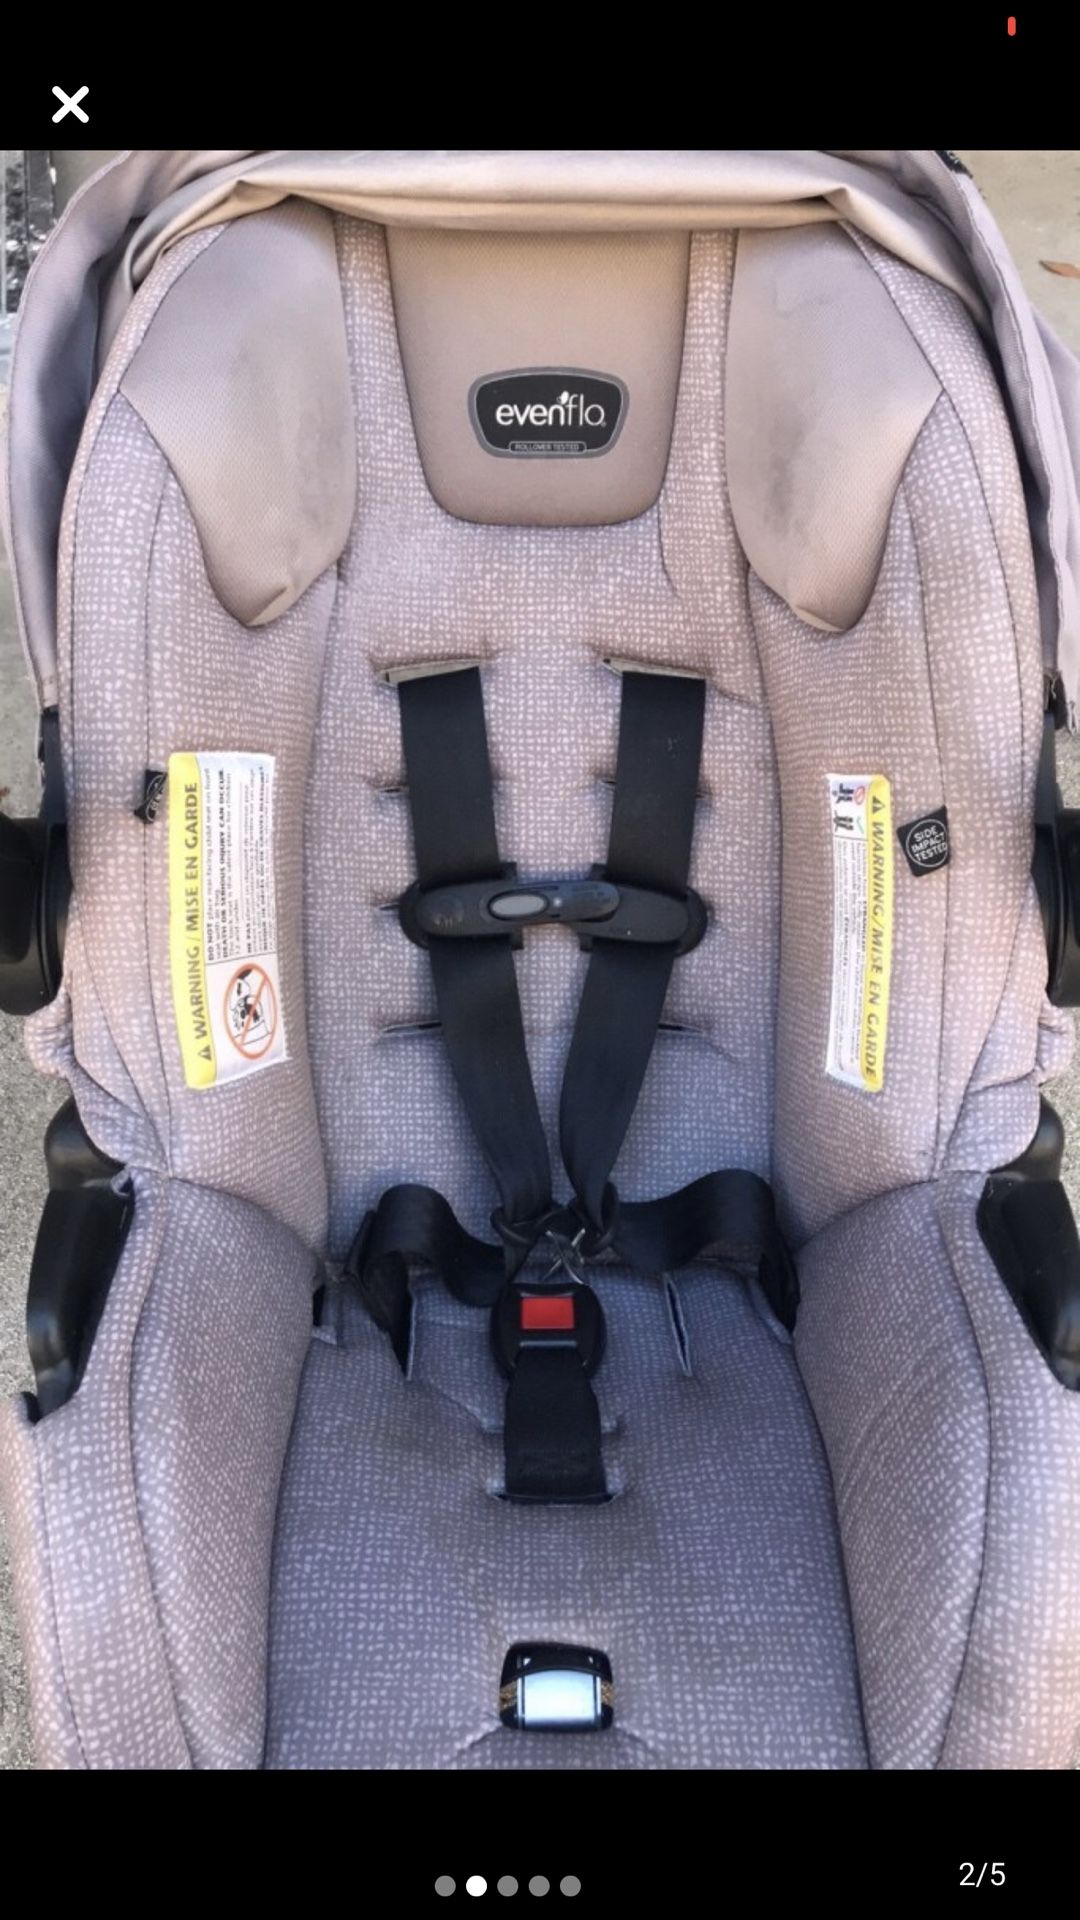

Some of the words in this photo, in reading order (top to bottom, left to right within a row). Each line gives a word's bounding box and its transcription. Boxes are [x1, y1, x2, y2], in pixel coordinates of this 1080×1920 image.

[495, 393, 605, 427] evenflo
[184, 783, 198, 849] GARDE
[911, 832, 945, 853] IMPACT
[913, 825, 938, 842] SIDE
[914, 842, 948, 861] TESTED
[184, 856, 199, 880] EN
[184, 886, 199, 931] MISE
[186, 946, 207, 1039] WARNING
[869, 980, 881, 1005] EN
[866, 1013, 879, 1077] GARDE
